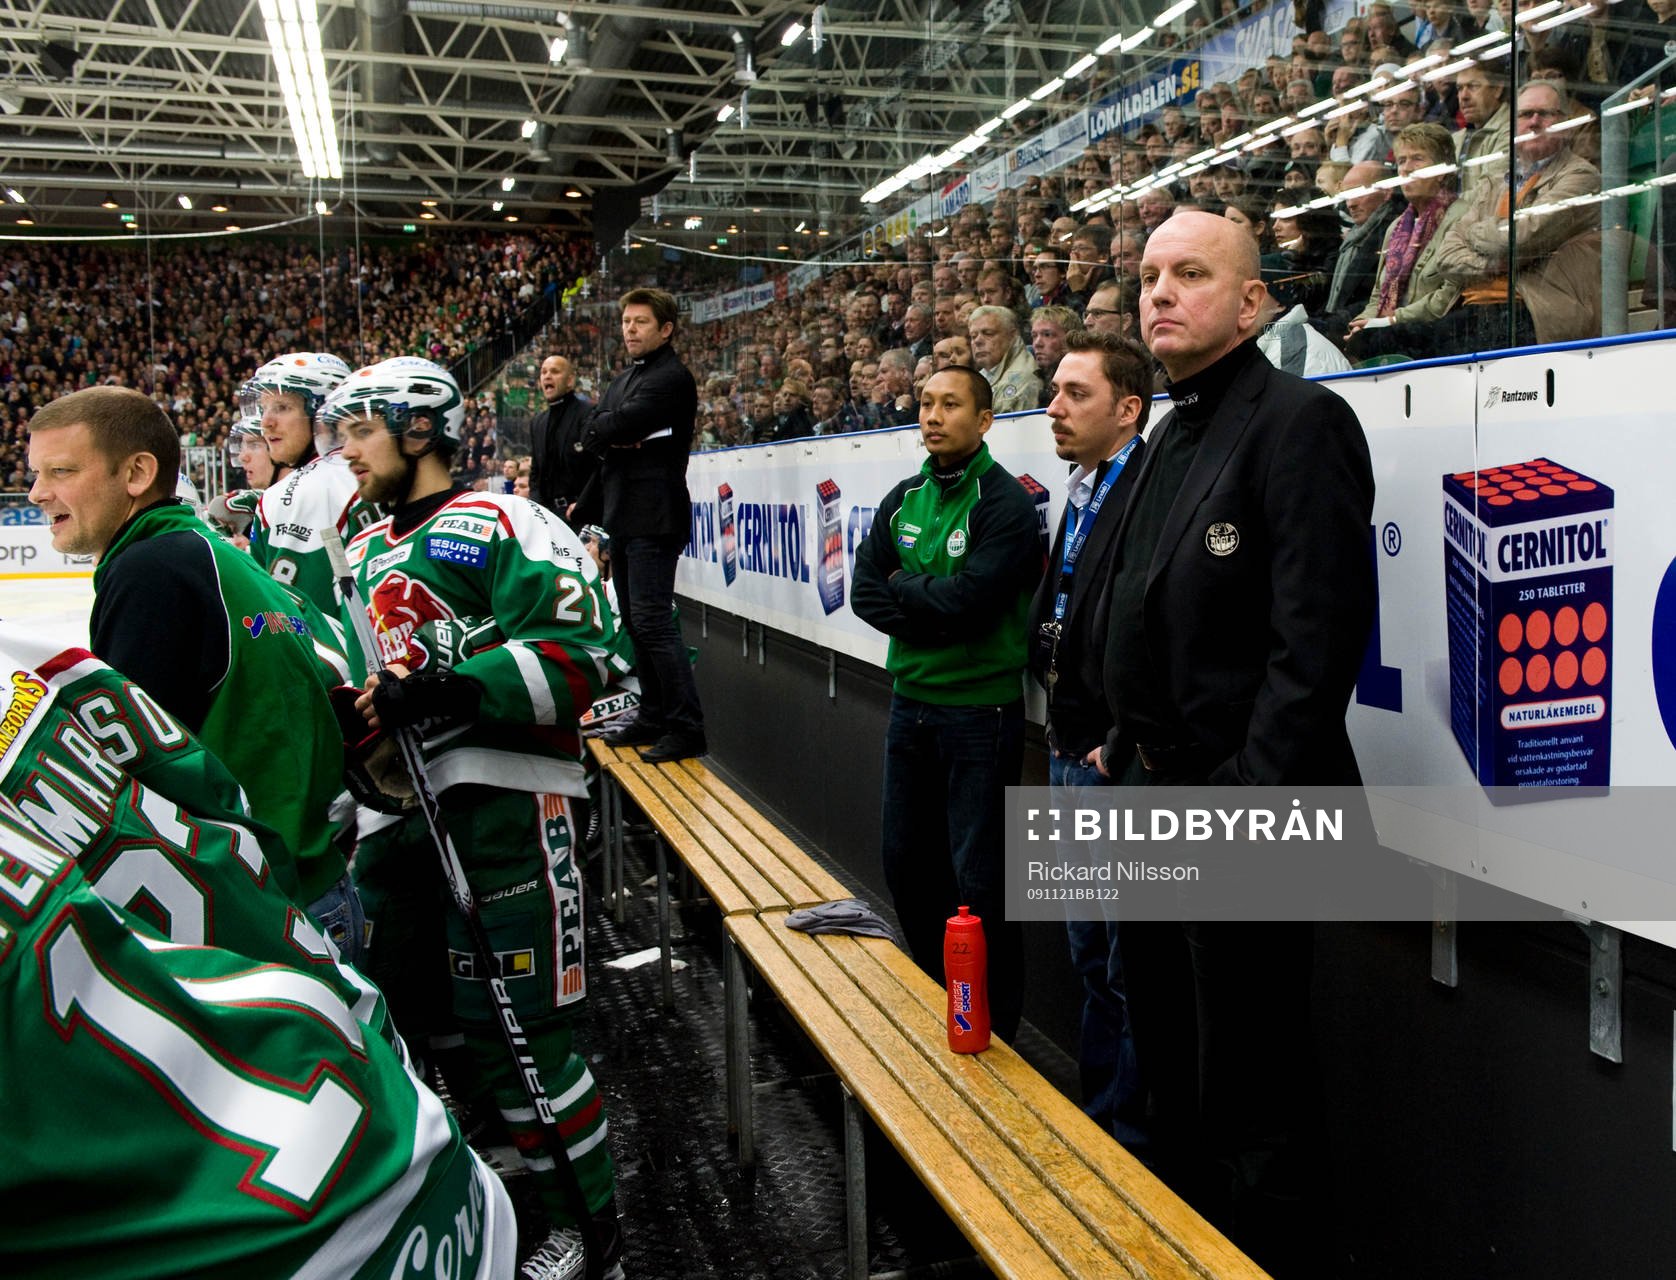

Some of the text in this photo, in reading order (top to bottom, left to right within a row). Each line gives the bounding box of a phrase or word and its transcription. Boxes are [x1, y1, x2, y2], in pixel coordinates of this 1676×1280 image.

[1501, 390, 1539, 402] Rantzows
[440, 519, 484, 535] PEAB
[1444, 501, 1488, 571] CERNITOL
[737, 501, 810, 584] CERNITOL
[1497, 521, 1607, 574] CERNITOL
[1519, 582, 1586, 601] 250 TABLETTER
[1517, 736, 1558, 749] Traditionellt
[1507, 754, 1518, 763] vid
[1515, 761, 1588, 776] orsakade av godartad
[544, 813, 581, 973] PEAB
[951, 942, 972, 955] 22
[953, 979, 963, 1013] INTER
[961, 981, 972, 1013] SPORT
